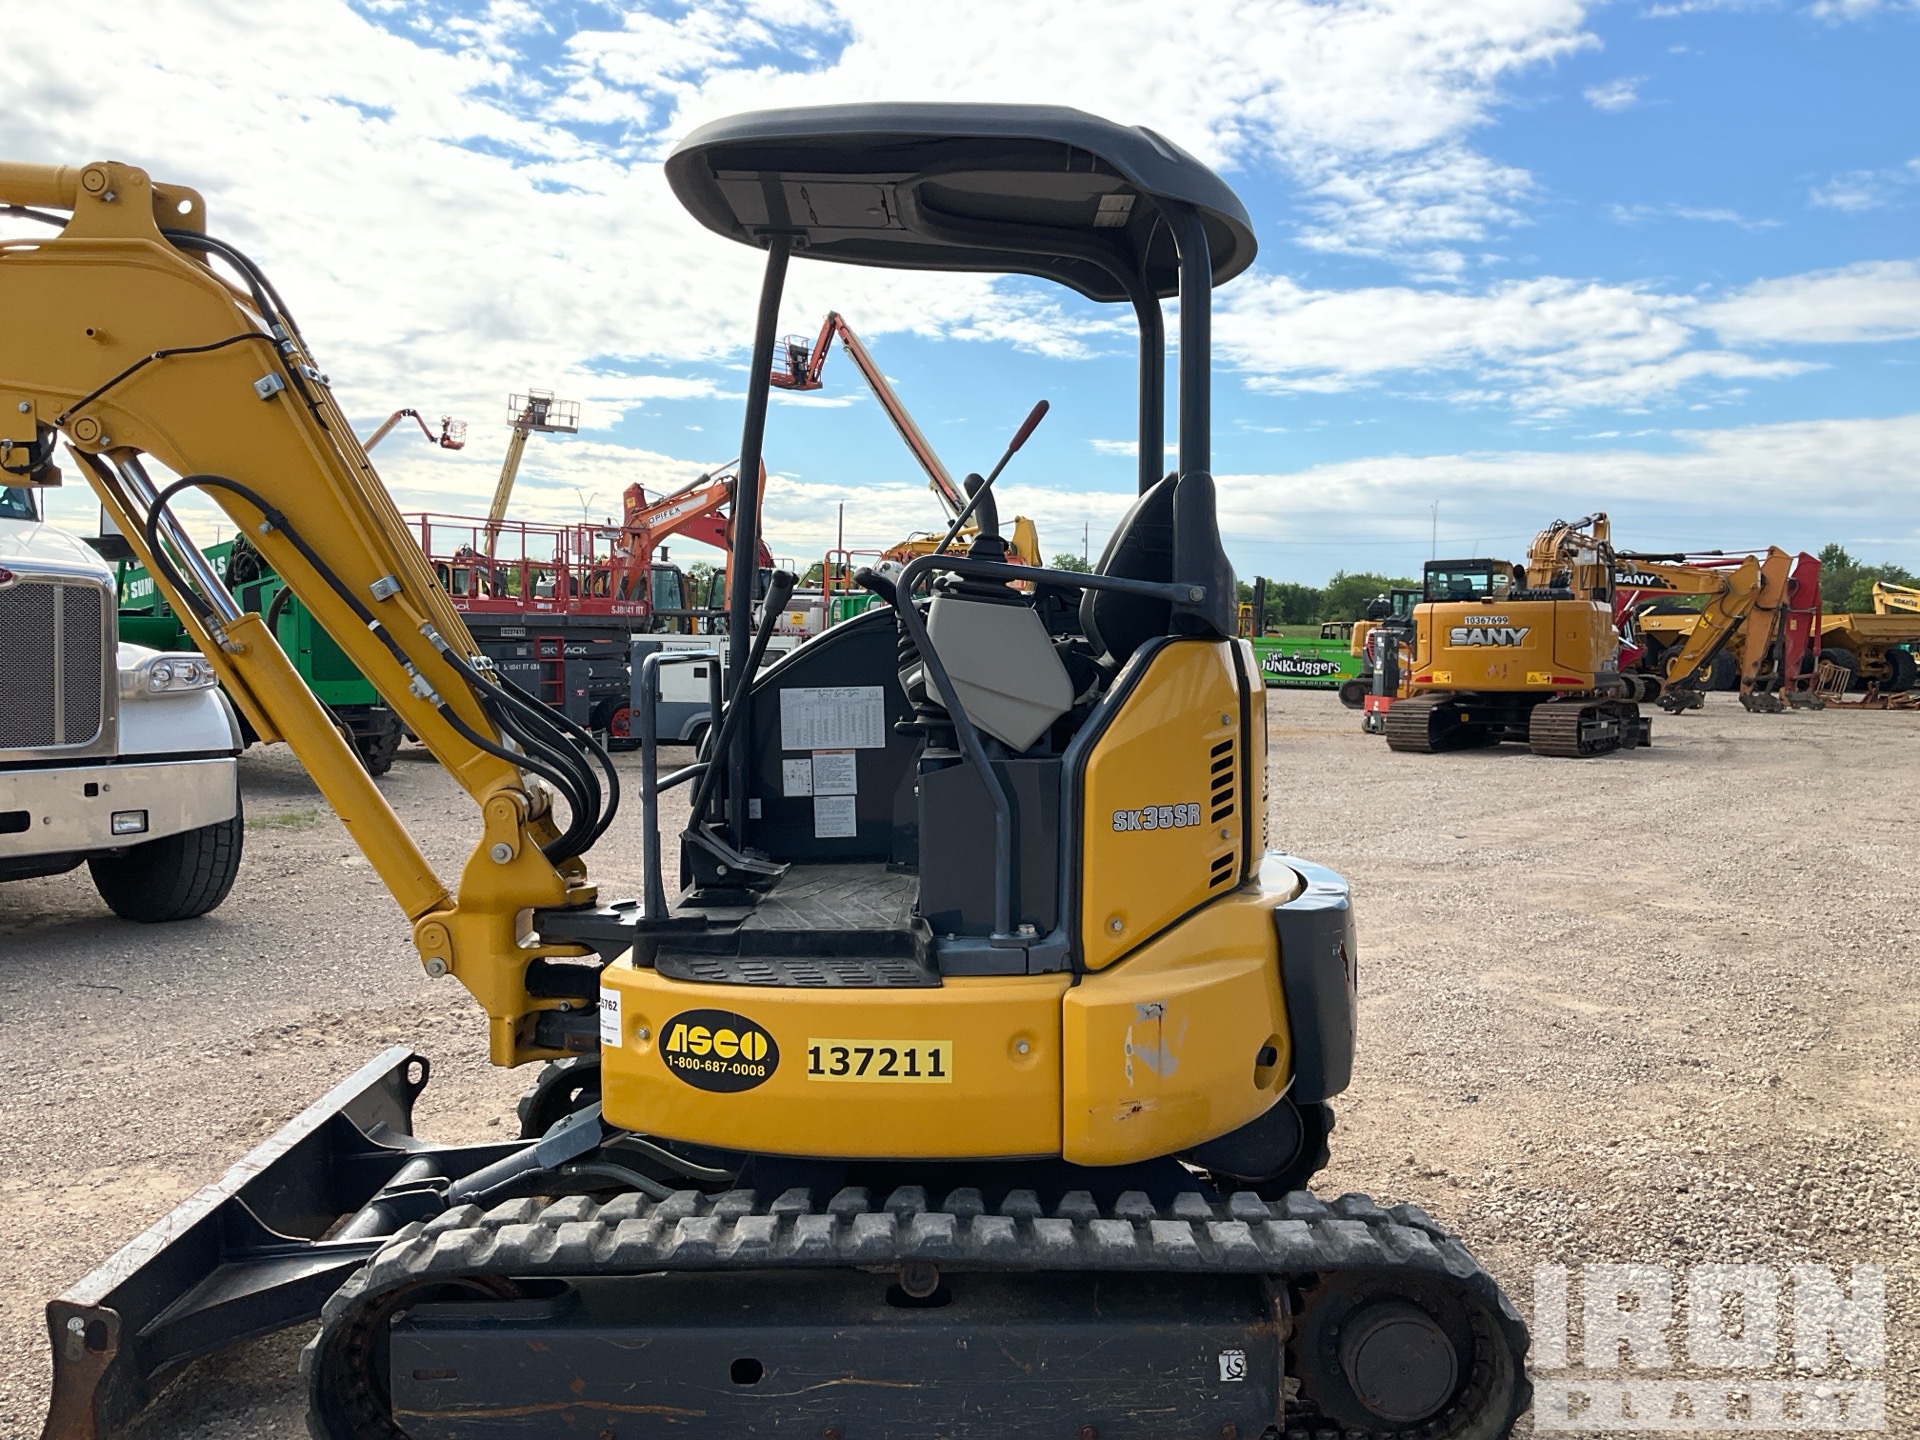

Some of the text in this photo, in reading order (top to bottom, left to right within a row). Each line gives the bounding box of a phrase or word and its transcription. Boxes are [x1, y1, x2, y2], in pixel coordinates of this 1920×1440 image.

[1615, 573, 1656, 585] SANY
[1465, 617, 1509, 625] 10367699
[1450, 627, 1531, 647] SANY
[1112, 803, 1200, 832] SK35SR
[666, 1023, 768, 1061] ASCO
[667, 1055, 766, 1077] 1-800-687-0008
[808, 1046, 945, 1077] 137211
